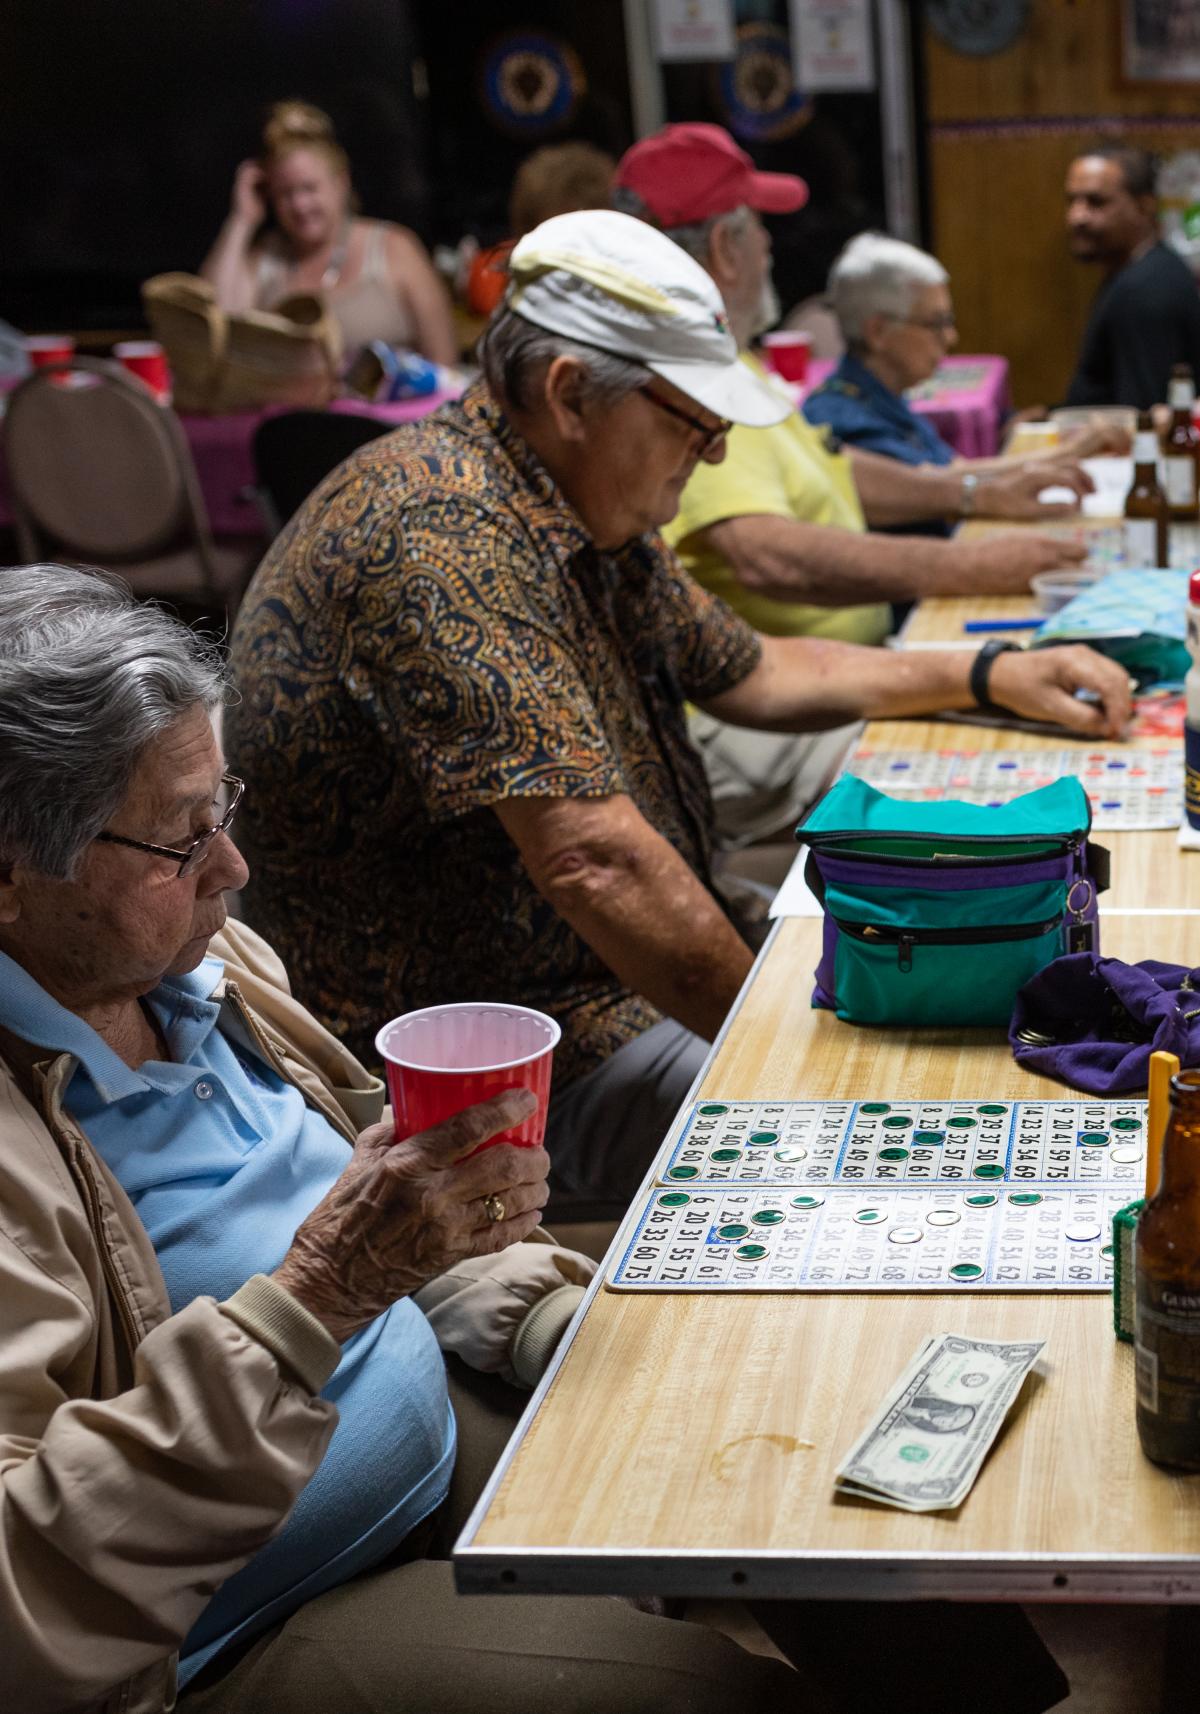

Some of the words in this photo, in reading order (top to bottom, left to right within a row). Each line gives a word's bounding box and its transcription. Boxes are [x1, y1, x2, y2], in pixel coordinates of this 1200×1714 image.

[826, 1106, 847, 1114] 11
[1024, 1107, 1043, 1115] 14
[1085, 1107, 1106, 1115] 10
[1117, 1107, 1136, 1115] 15
[695, 1120, 718, 1130] 30
[727, 1120, 748, 1130] 19
[758, 1120, 780, 1129] 27
[822, 1120, 843, 1129] 24
[856, 1121, 877, 1129] 17
[919, 1119, 940, 1129] 23
[982, 1119, 1003, 1129] 29
[1021, 1119, 1042, 1129] 23
[1053, 1120, 1073, 1129] 20
[1084, 1120, 1105, 1129] 28
[688, 1135, 711, 1145] 38
[719, 1135, 742, 1145] 40
[816, 1134, 838, 1144] 36
[851, 1134, 873, 1144] 36
[884, 1134, 905, 1144] 38
[947, 1134, 969, 1144] 32
[980, 1134, 1000, 1144] 37
[1019, 1134, 1040, 1144] 36
[1051, 1134, 1072, 1144] 41
[681, 1151, 704, 1161] 60
[745, 1151, 769, 1161] 54
[813, 1150, 834, 1160] 51
[847, 1150, 869, 1160] 49
[911, 1150, 933, 1160] 60
[945, 1150, 967, 1160] 57
[977, 1150, 998, 1160] 50
[1017, 1150, 1038, 1160] 54
[1050, 1150, 1070, 1161] 59
[1081, 1150, 1102, 1161] 58
[707, 1167, 731, 1179] 74
[740, 1167, 764, 1178] 70
[805, 1166, 829, 1178] 68
[842, 1166, 865, 1177] 68
[876, 1166, 897, 1178] 64
[908, 1166, 930, 1177] 61
[942, 1166, 963, 1178] 69
[1014, 1166, 1036, 1178] 69
[1047, 1166, 1069, 1178] 75
[1080, 1167, 1101, 1177] 71
[650, 1211, 676, 1223] 26
[684, 1212, 709, 1223] 20
[719, 1211, 744, 1223] 25
[642, 1229, 668, 1241] 33
[676, 1230, 702, 1241] 31
[634, 1247, 659, 1260] 60
[669, 1248, 694, 1261] 55
[705, 1248, 730, 1261] 57
[625, 1266, 652, 1279] 75
[660, 1267, 688, 1280] 72
[699, 1266, 723, 1278] 61
[734, 1266, 759, 1279] 70
[845, 1266, 871, 1280] 72
[882, 1266, 907, 1280] 68
[918, 1266, 942, 1279] 73
[996, 1266, 1020, 1280] 62
[1033, 1266, 1056, 1279] 74
[1069, 1266, 1093, 1280] 69
